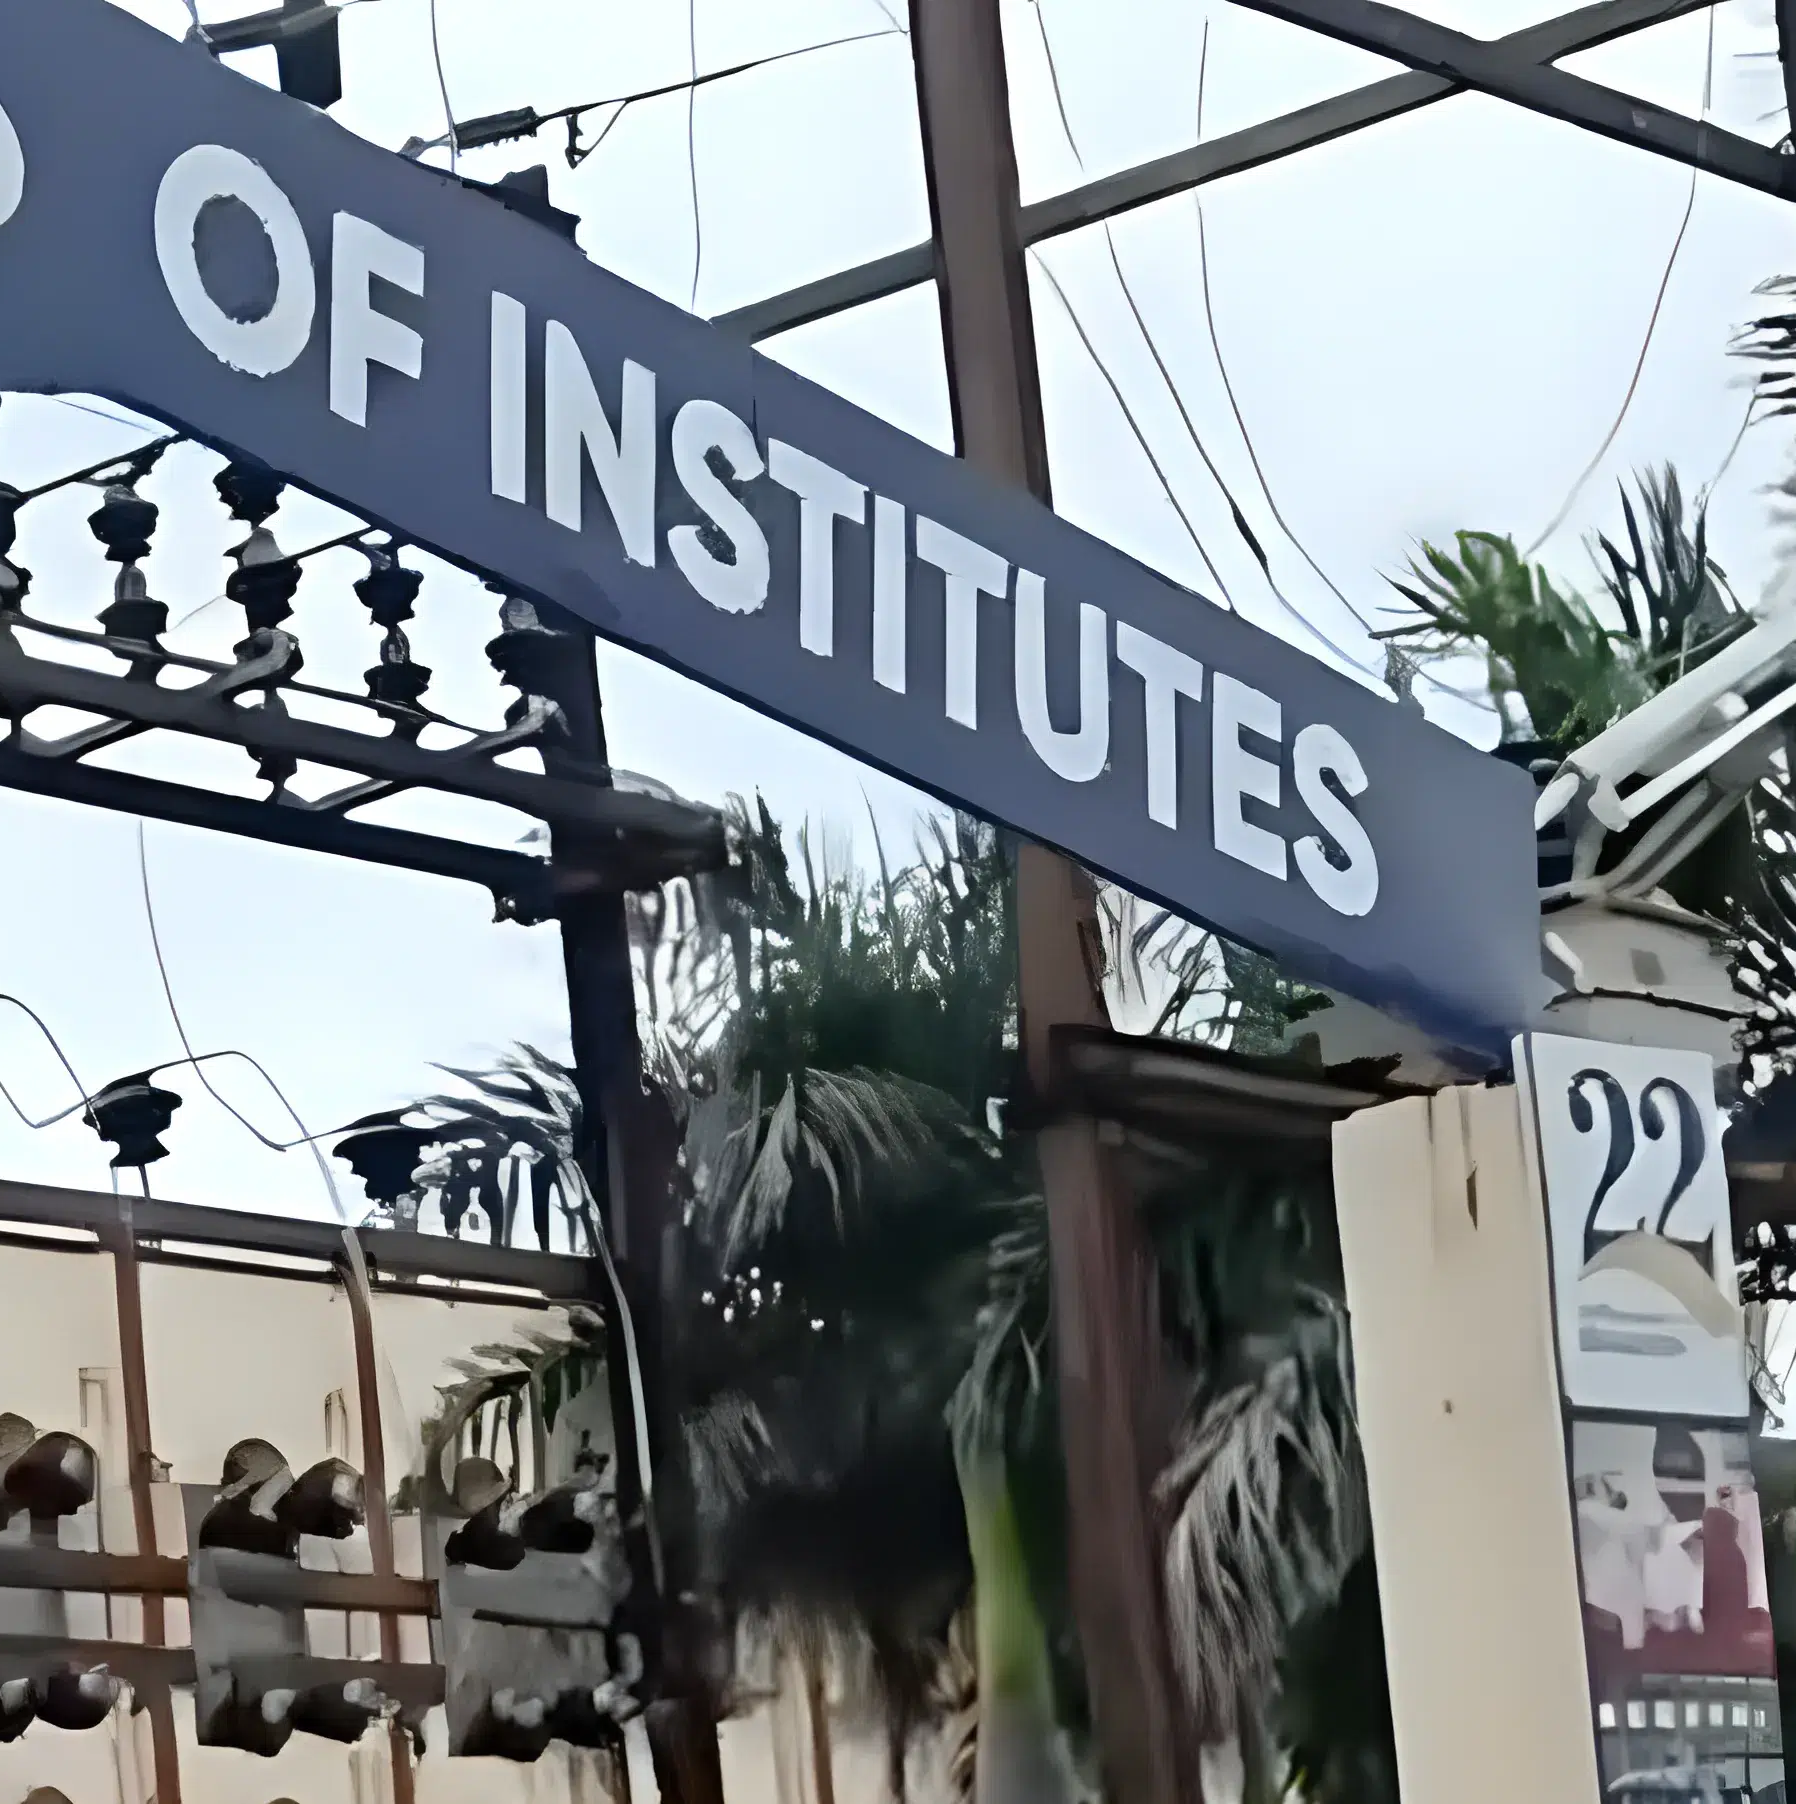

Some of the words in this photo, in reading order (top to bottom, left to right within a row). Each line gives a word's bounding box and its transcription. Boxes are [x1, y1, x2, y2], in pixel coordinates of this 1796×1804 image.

[153, 142, 425, 428] OF
[489, 289, 1380, 918] INSTITUTES
[1567, 1067, 1715, 1270] 22
